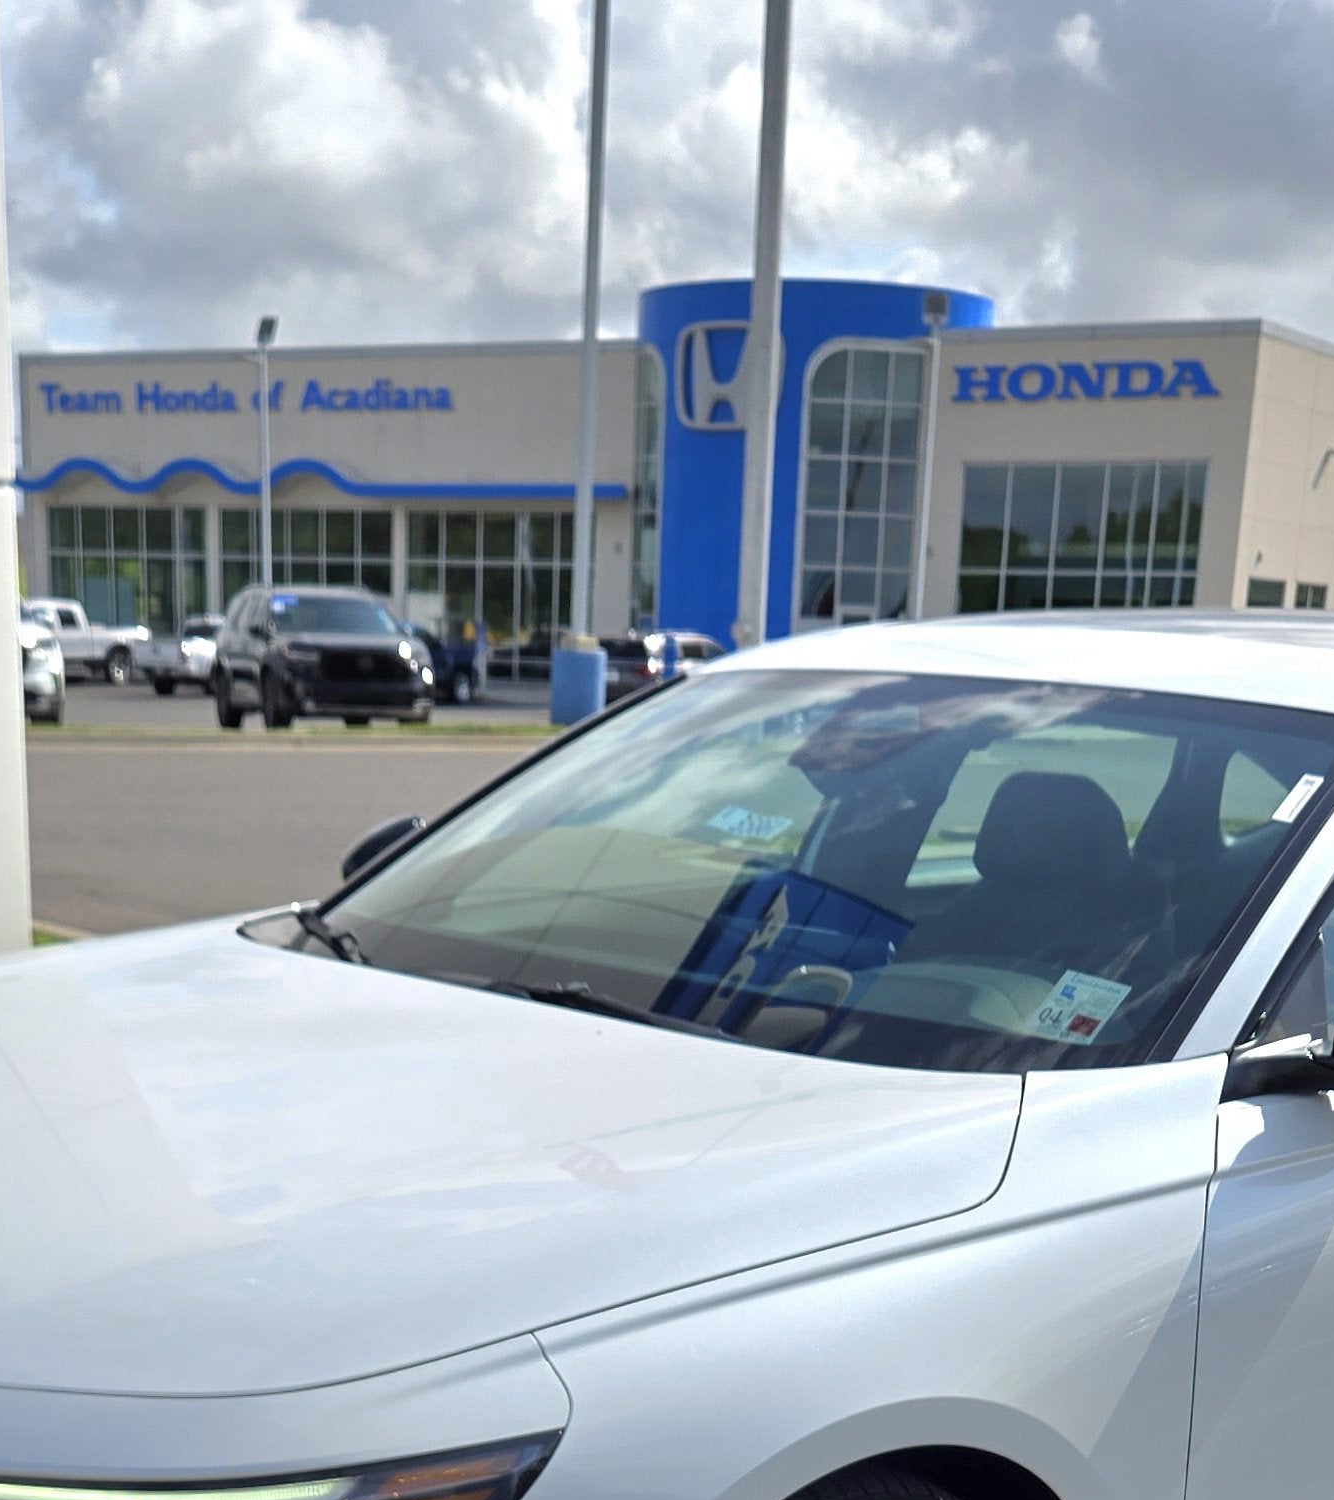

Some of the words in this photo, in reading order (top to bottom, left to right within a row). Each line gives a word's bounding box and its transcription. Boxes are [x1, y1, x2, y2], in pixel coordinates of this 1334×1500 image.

[40, 381, 121, 413] Team
[135, 380, 237, 412] Honda
[251, 379, 283, 411] of
[300, 378, 452, 411] Acadiana
[951, 358, 1220, 401] HONDA
